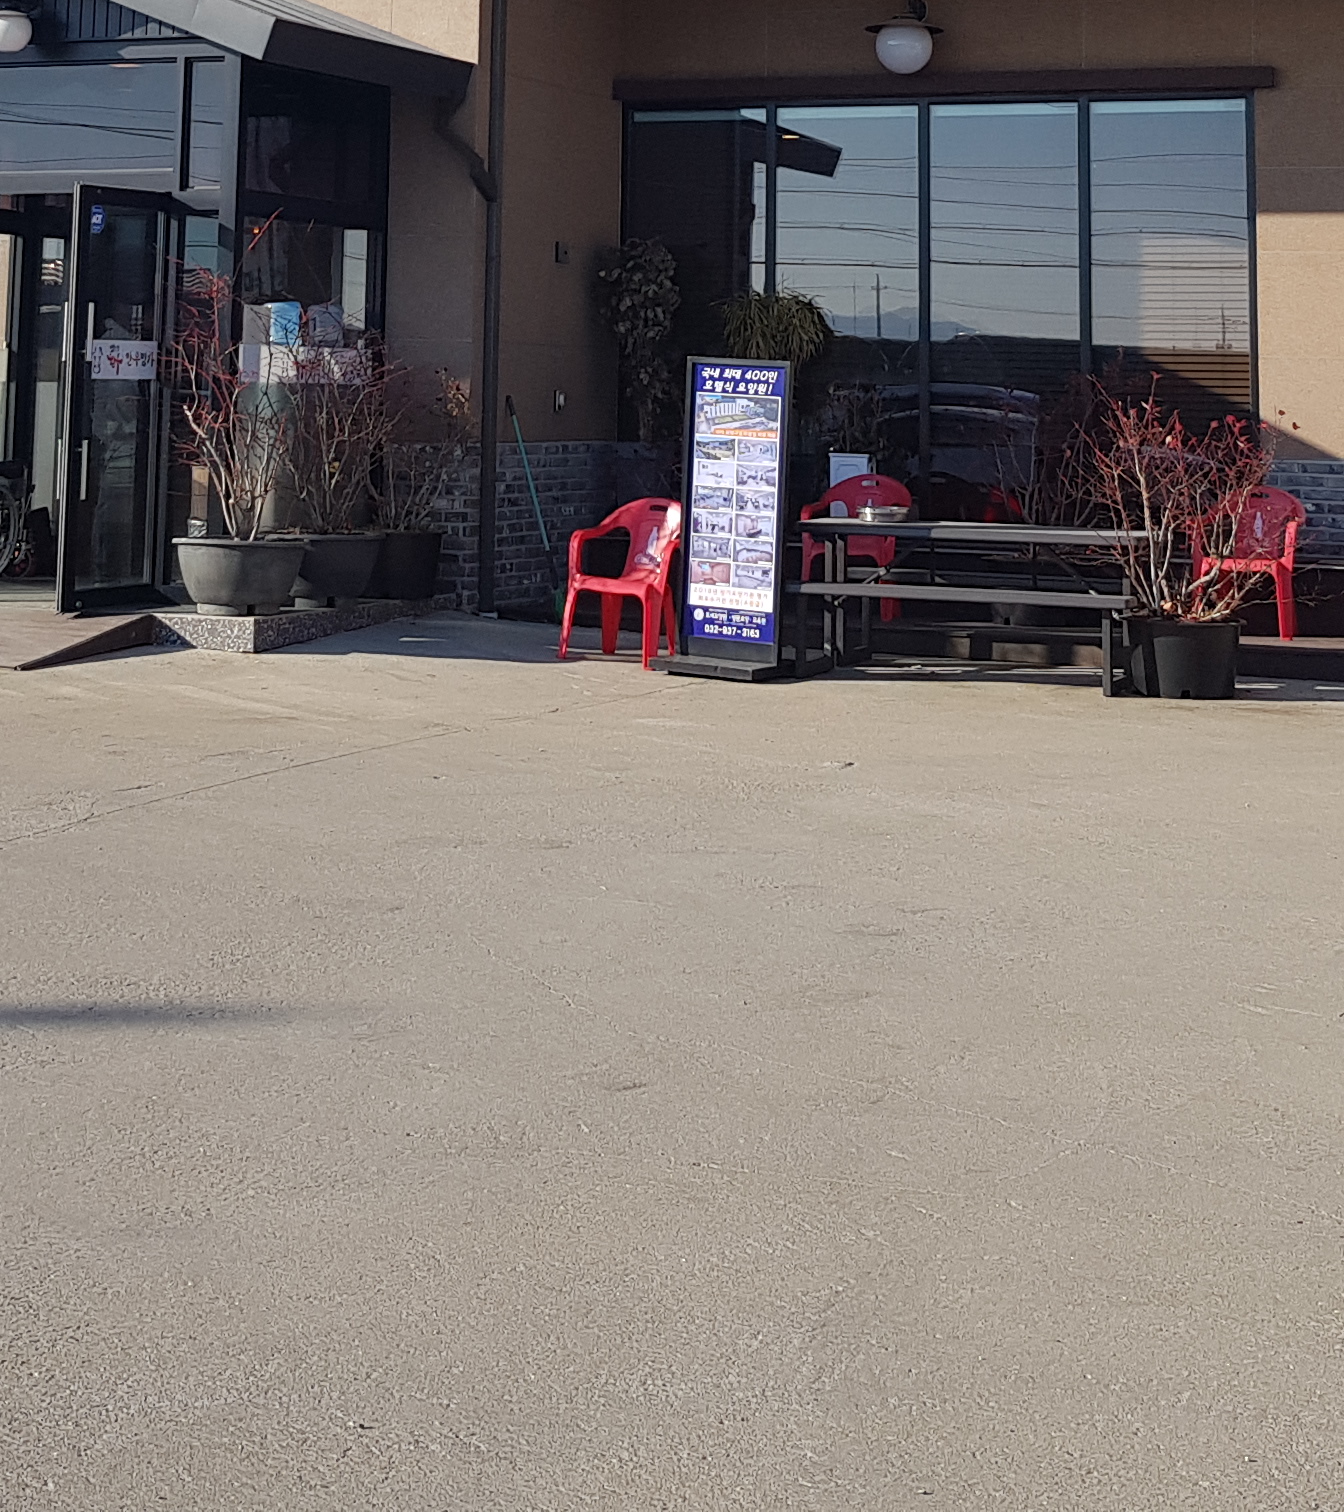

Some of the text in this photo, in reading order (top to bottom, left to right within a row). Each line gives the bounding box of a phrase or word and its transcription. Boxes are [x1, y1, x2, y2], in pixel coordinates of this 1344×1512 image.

[701, 367, 778, 383] 국내 최대 400인
[702, 380, 773, 395] 호텔식 요양원!
